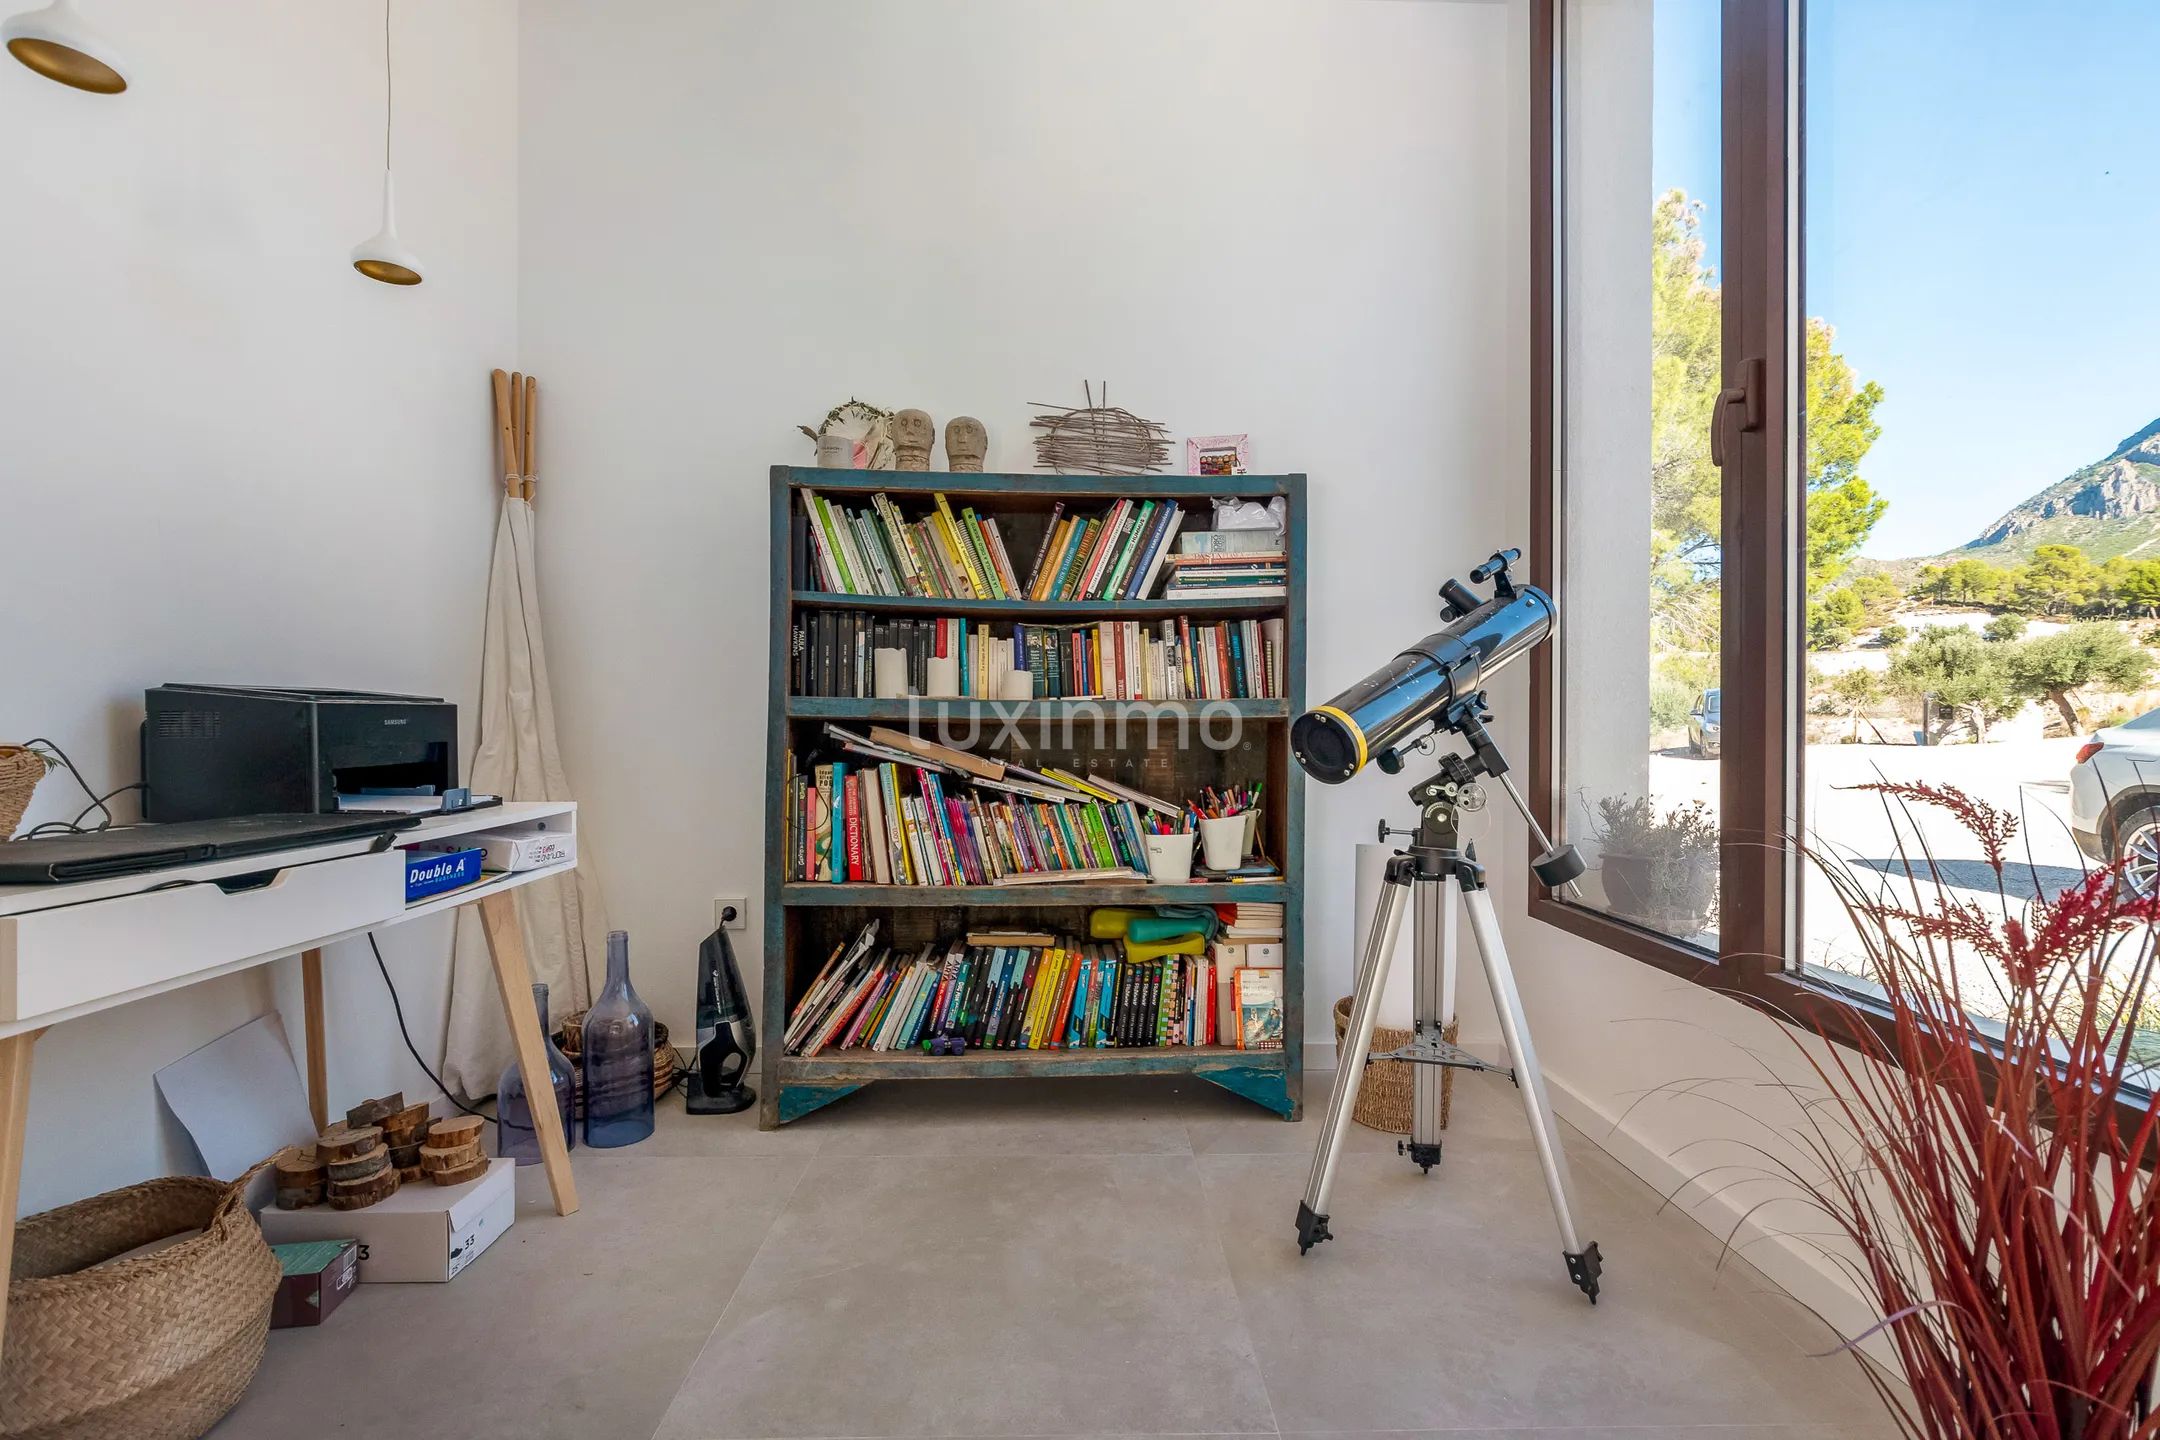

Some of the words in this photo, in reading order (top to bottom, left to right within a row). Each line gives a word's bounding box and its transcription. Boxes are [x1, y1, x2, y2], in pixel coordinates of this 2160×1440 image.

[1130, 518, 1144, 543] HUMMUS
[1150, 532, 1160, 549] KARLOS
[848, 817, 859, 865] DICTIONARY
[410, 863, 452, 883] Double
[456, 858, 465, 872] A
[941, 960, 953, 983] ARTA
[949, 959, 961, 982] ARTA
[358, 1245, 370, 1261] 3
[465, 1234, 475, 1250] 33
